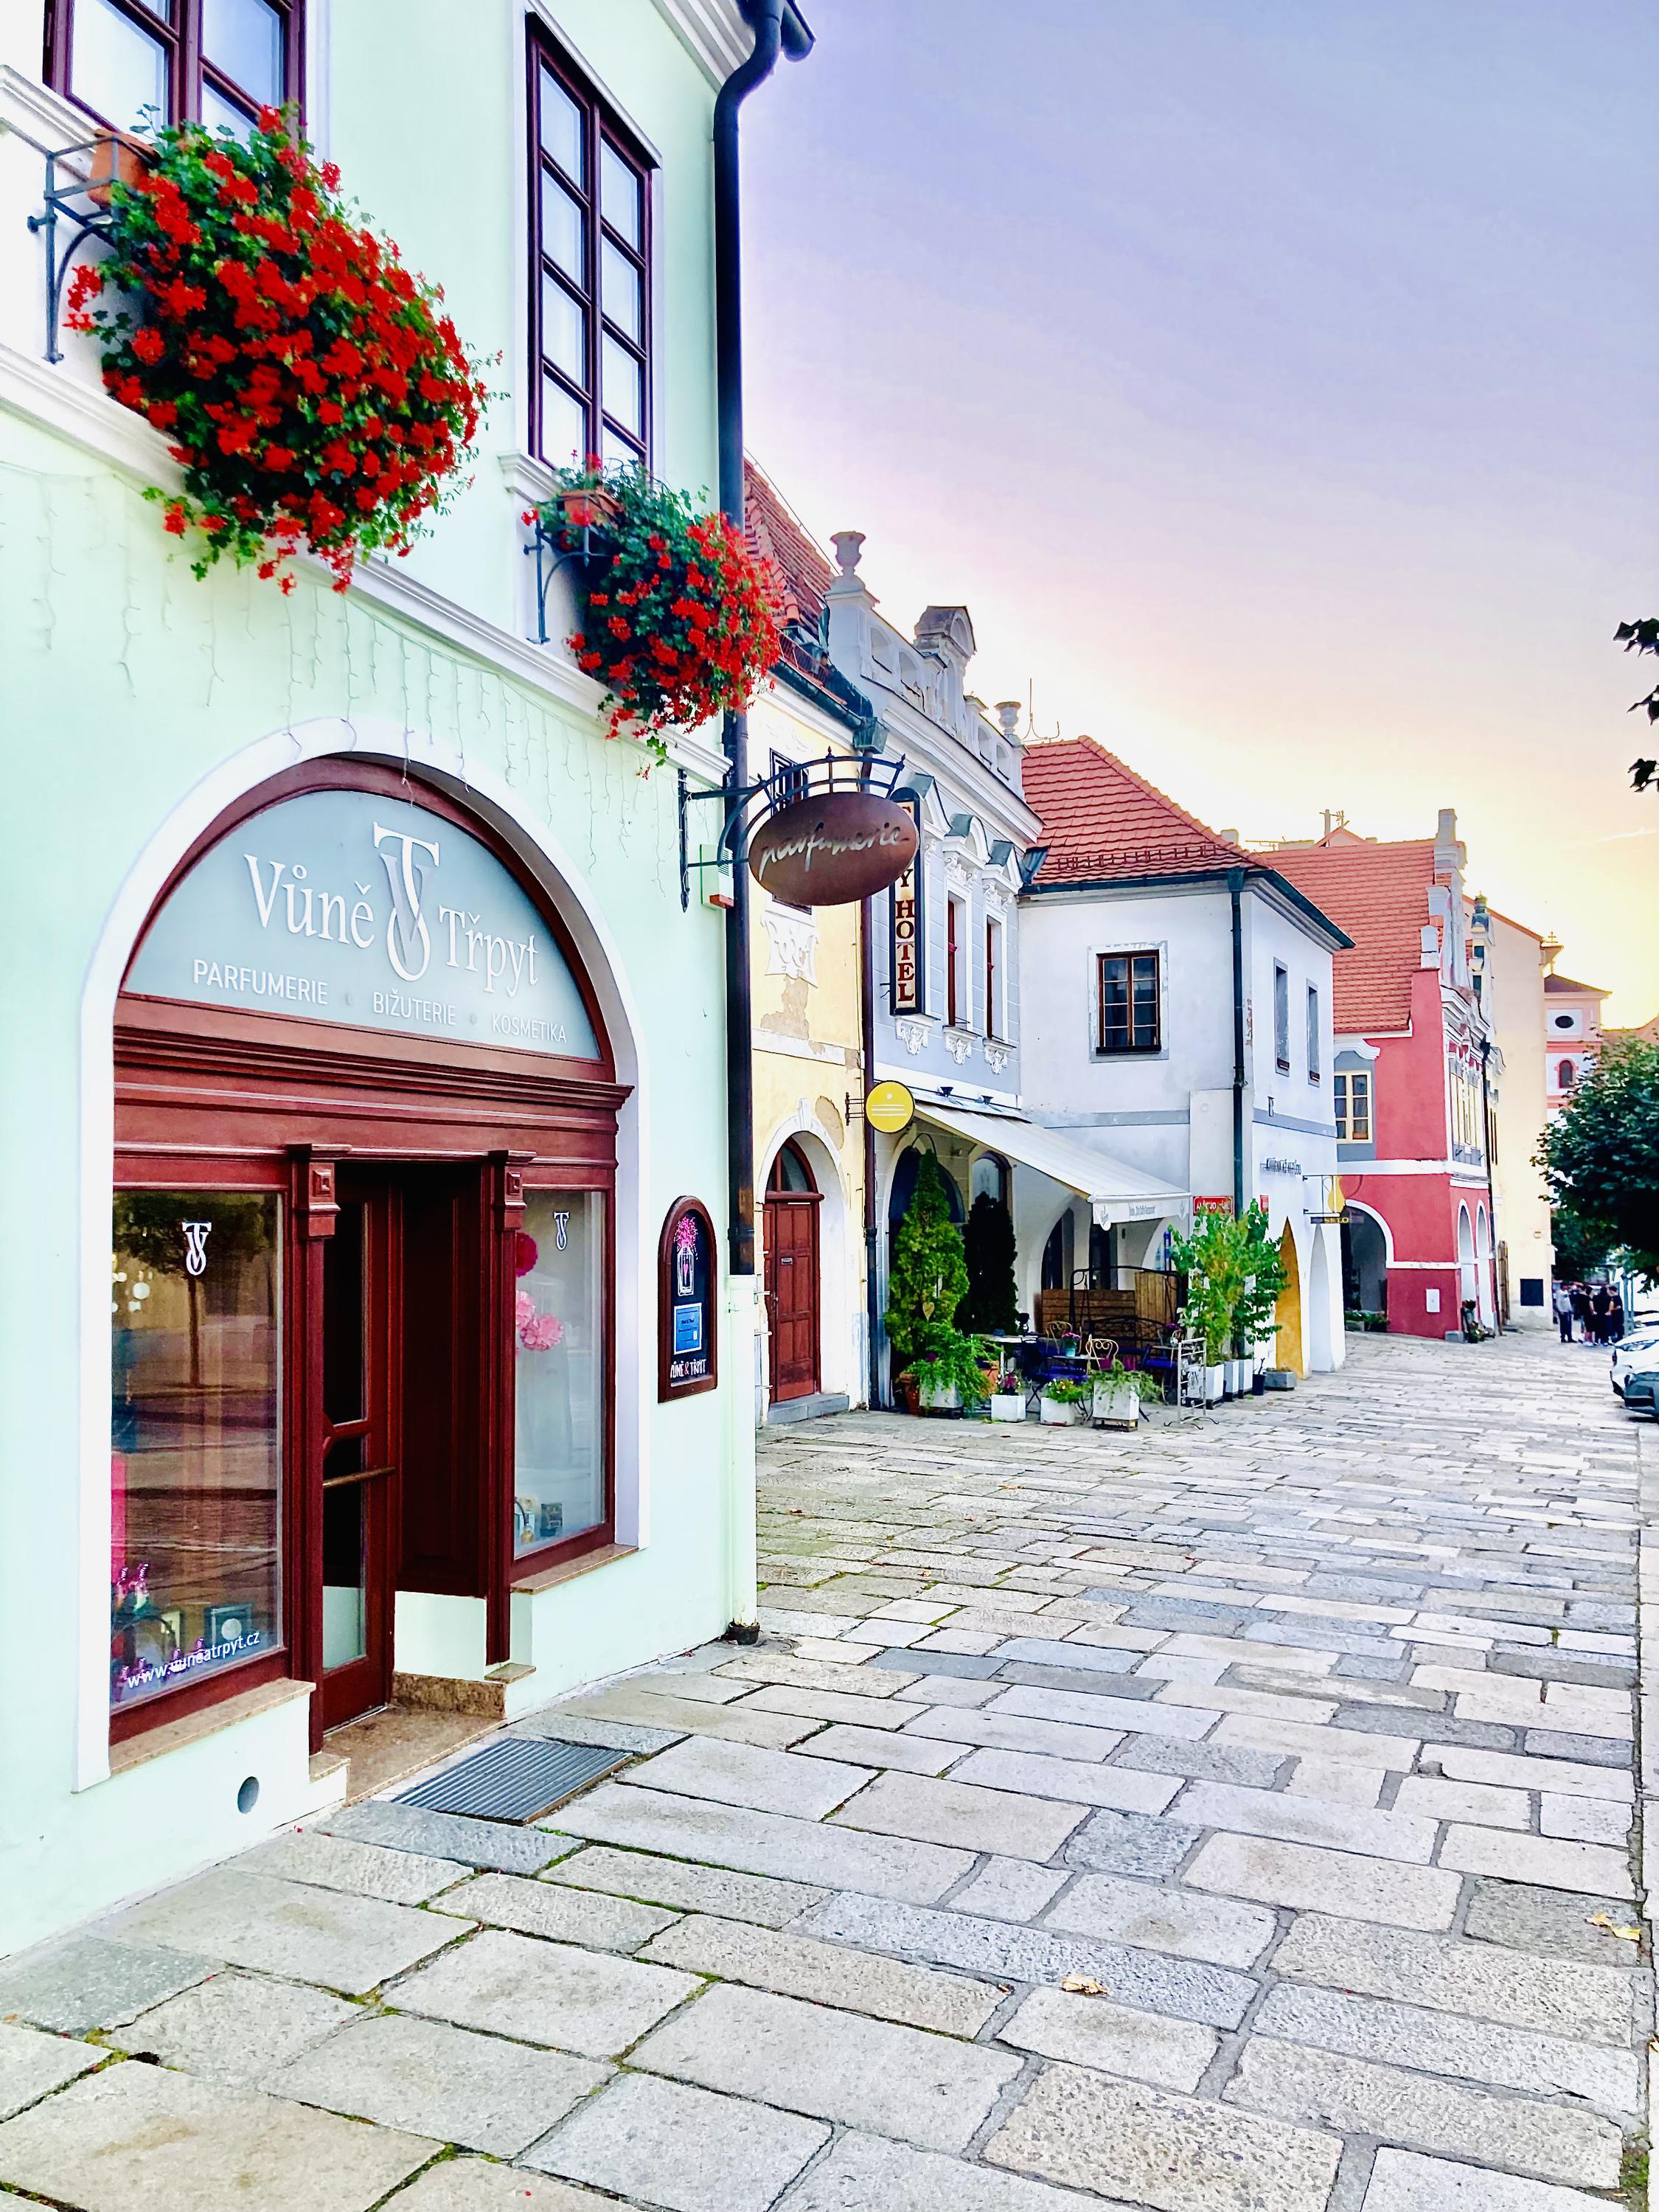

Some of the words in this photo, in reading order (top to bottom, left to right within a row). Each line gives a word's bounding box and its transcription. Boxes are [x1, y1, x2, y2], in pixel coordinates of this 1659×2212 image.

[759, 821, 910, 882] parfumerie
[243, 853, 375, 949] Vůně
[439, 904, 539, 998] Třpyt
[894, 899, 915, 1002] HOTEL
[192, 959, 329, 1005] PARFUMERIE
[372, 988, 457, 1026] BIŽUTERIE
[492, 1012, 567, 1043] KOSMETIKA
[684, 1361, 689, 1375] &
